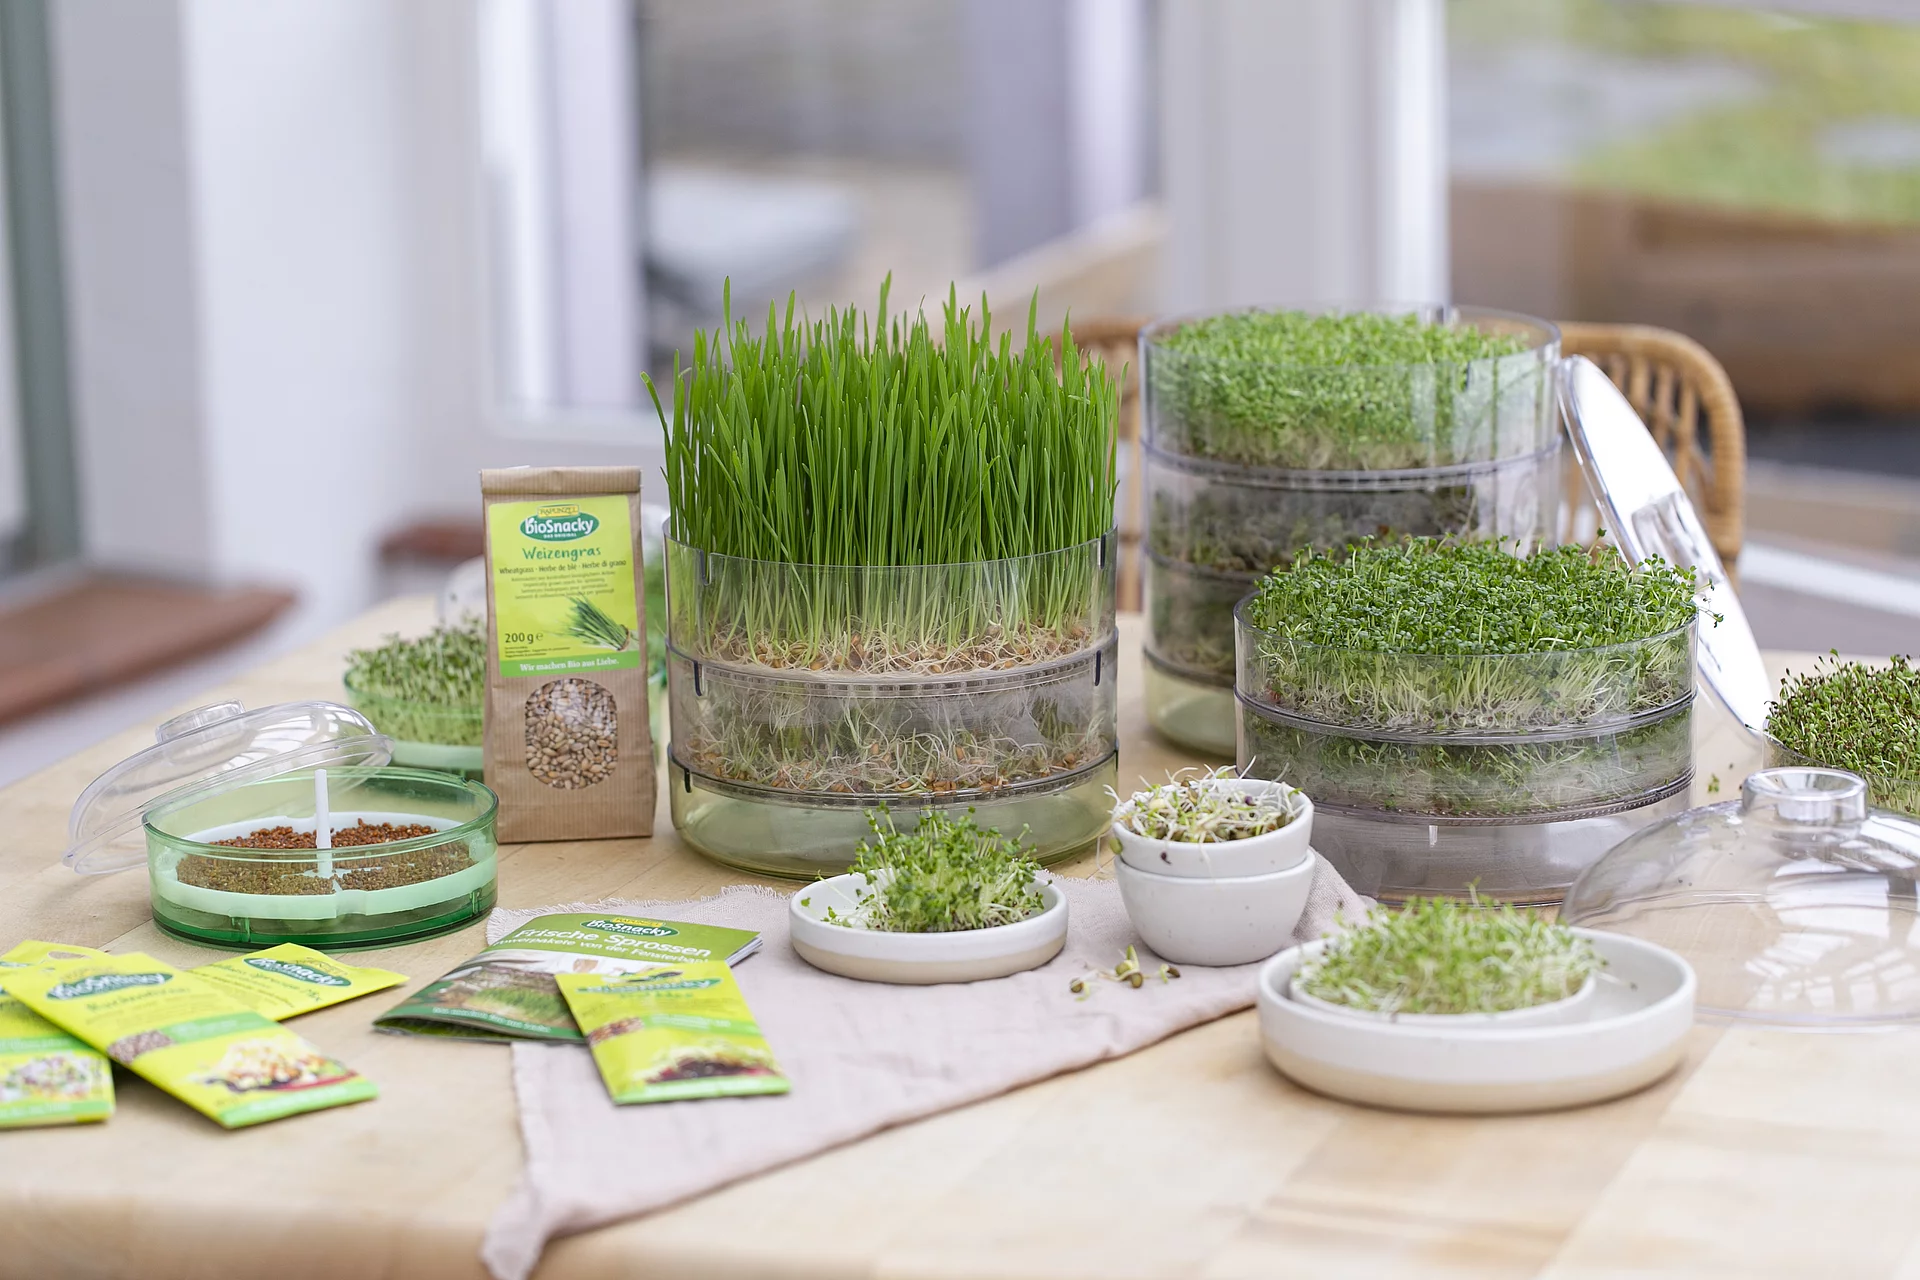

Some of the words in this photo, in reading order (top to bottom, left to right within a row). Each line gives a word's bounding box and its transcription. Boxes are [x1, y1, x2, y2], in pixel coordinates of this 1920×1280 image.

[522, 546, 601, 561] Weizengras
[499, 566, 534, 575] Wheatgrass
[505, 632, 525, 643] 200
[527, 633, 534, 645] g
[520, 663, 534, 672] Wir
[536, 661, 567, 671] machen
[567, 660, 581, 669] Bio
[582, 660, 595, 668] aus
[512, 929, 599, 940] Frische
[604, 934, 712, 957] Sprossen
[605, 945, 628, 953] der
